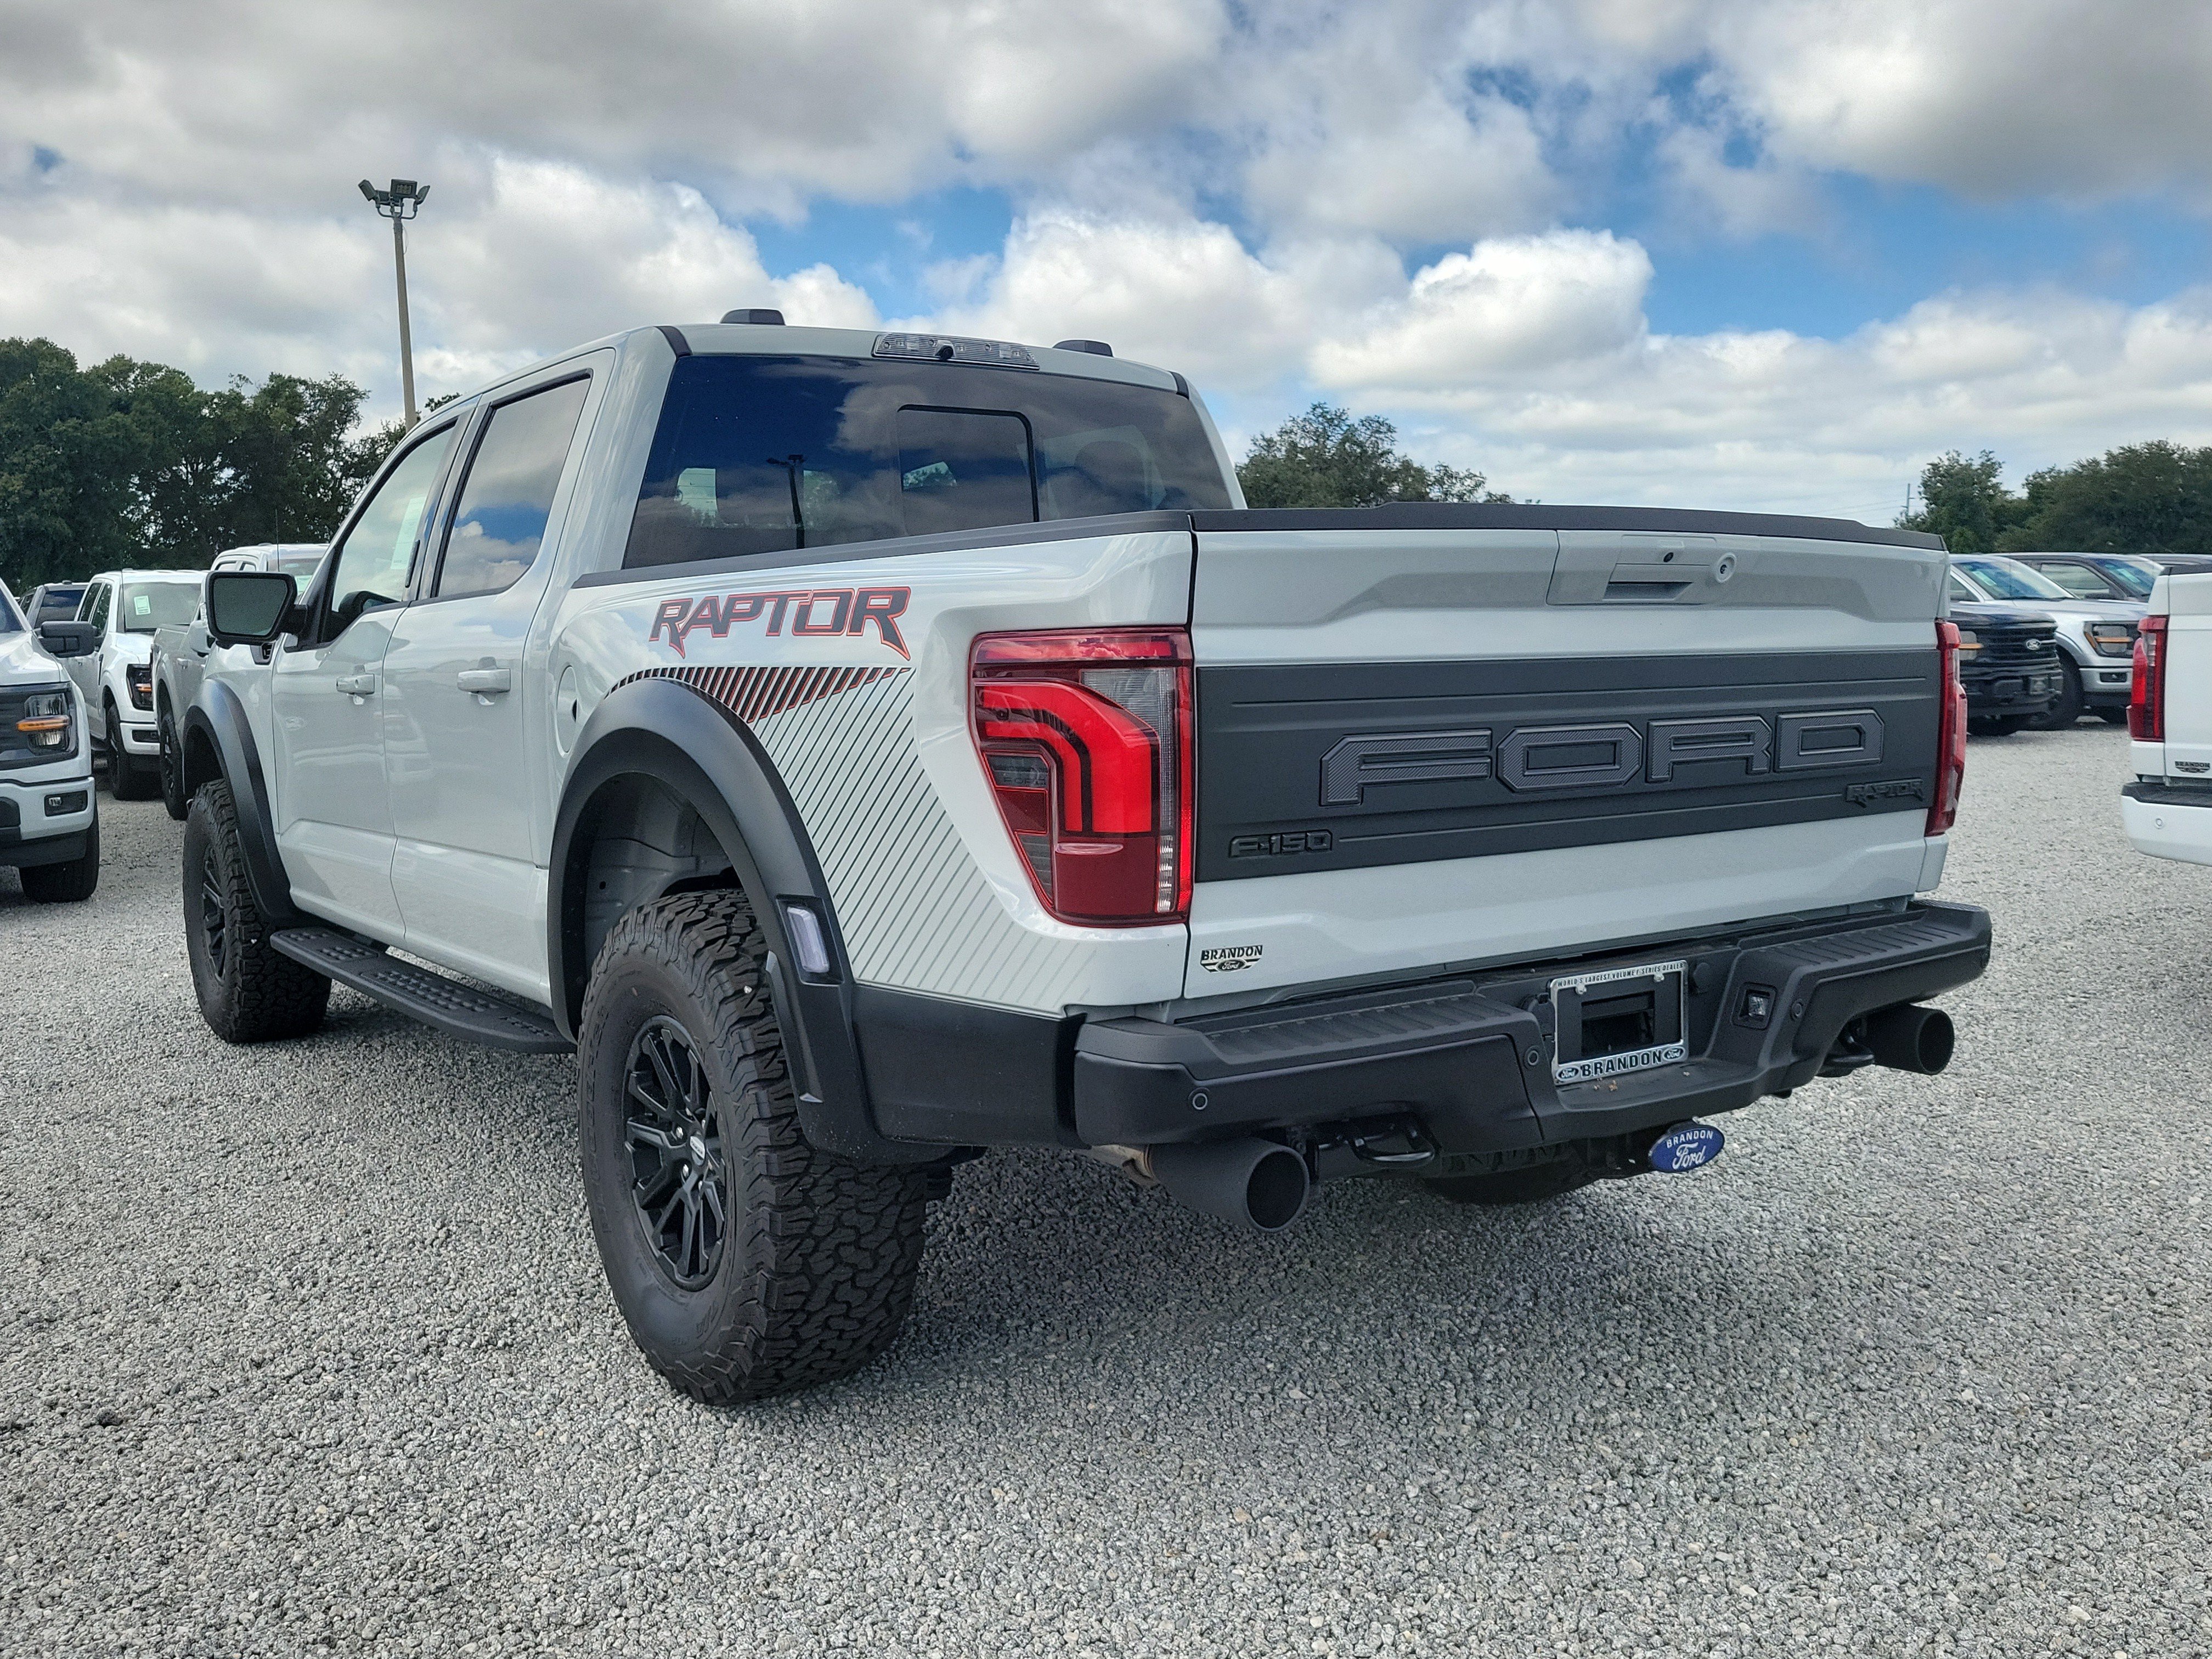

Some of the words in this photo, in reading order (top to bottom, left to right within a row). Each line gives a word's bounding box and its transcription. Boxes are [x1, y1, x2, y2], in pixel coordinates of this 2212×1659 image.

[648, 586, 911, 661] RAPTOR
[1319, 708, 1885, 807] FORD
[1845, 777, 1924, 808] RAPTOR
[1228, 829, 1333, 859] F-150
[1201, 945, 1263, 961] BRANDON
[1585, 974, 1610, 983] LARGEST
[1612, 970, 1634, 979] VOLUME
[1636, 966, 1660, 975] F-SERIES
[1662, 963, 1684, 971] DEALER
[1581, 1049, 1662, 1077] BRANDON
[1666, 1130, 1714, 1149] BRANDON
[1672, 1142, 1706, 1170] Ford
